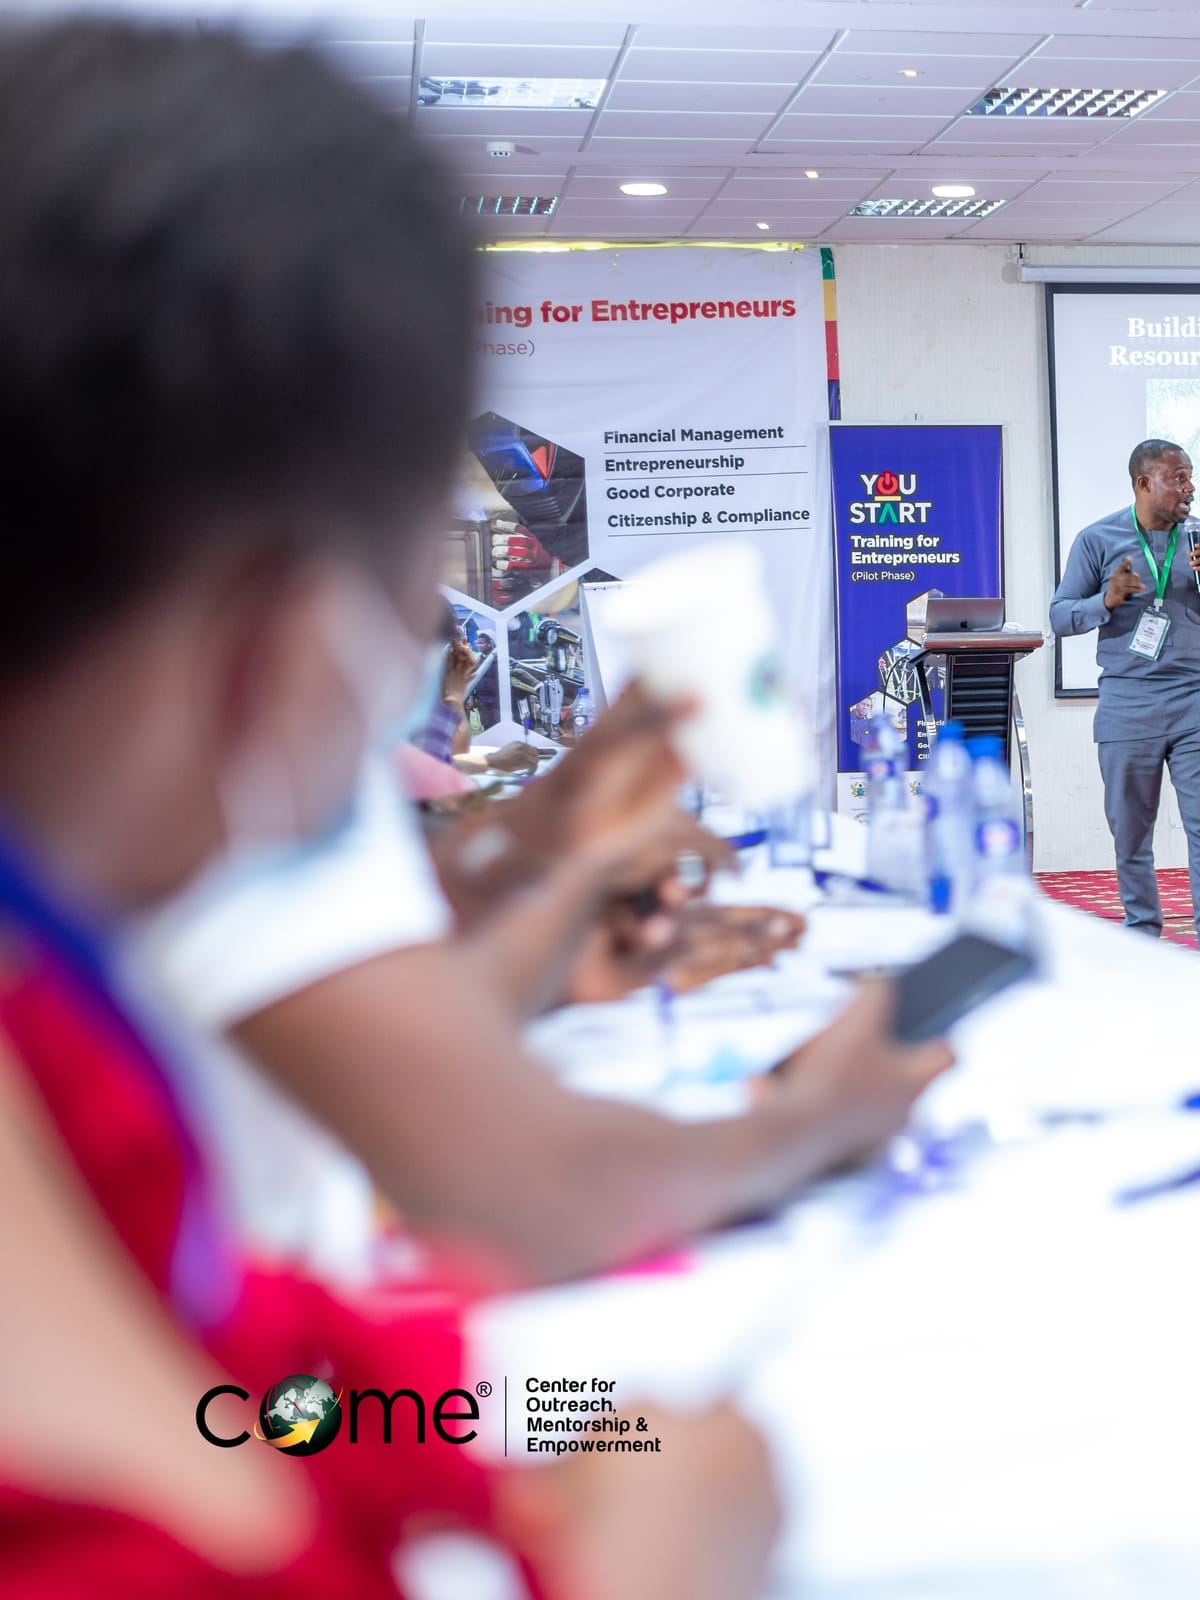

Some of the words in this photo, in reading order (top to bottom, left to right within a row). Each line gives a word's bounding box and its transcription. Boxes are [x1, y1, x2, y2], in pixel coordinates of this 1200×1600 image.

[540, 300, 583, 324] for
[591, 298, 797, 325] Entrepreneurs
[481, 339, 536, 358] hase)
[604, 428, 676, 444] Financial
[681, 425, 784, 443] Management
[605, 454, 745, 473] Entrepreneurship
[606, 485, 650, 500] Good
[654, 483, 735, 499] Corporate
[860, 470, 917, 495] YOU
[607, 512, 698, 528] Citizenship
[702, 512, 713, 524] &
[717, 508, 811, 525] Compliance
[850, 502, 932, 524] START
[850, 534, 913, 550] Training
[917, 534, 940, 548] for
[851, 551, 961, 566] Entrepreneurs
[851, 571, 879, 582] (Pilot
[881, 570, 915, 581] Phase)
